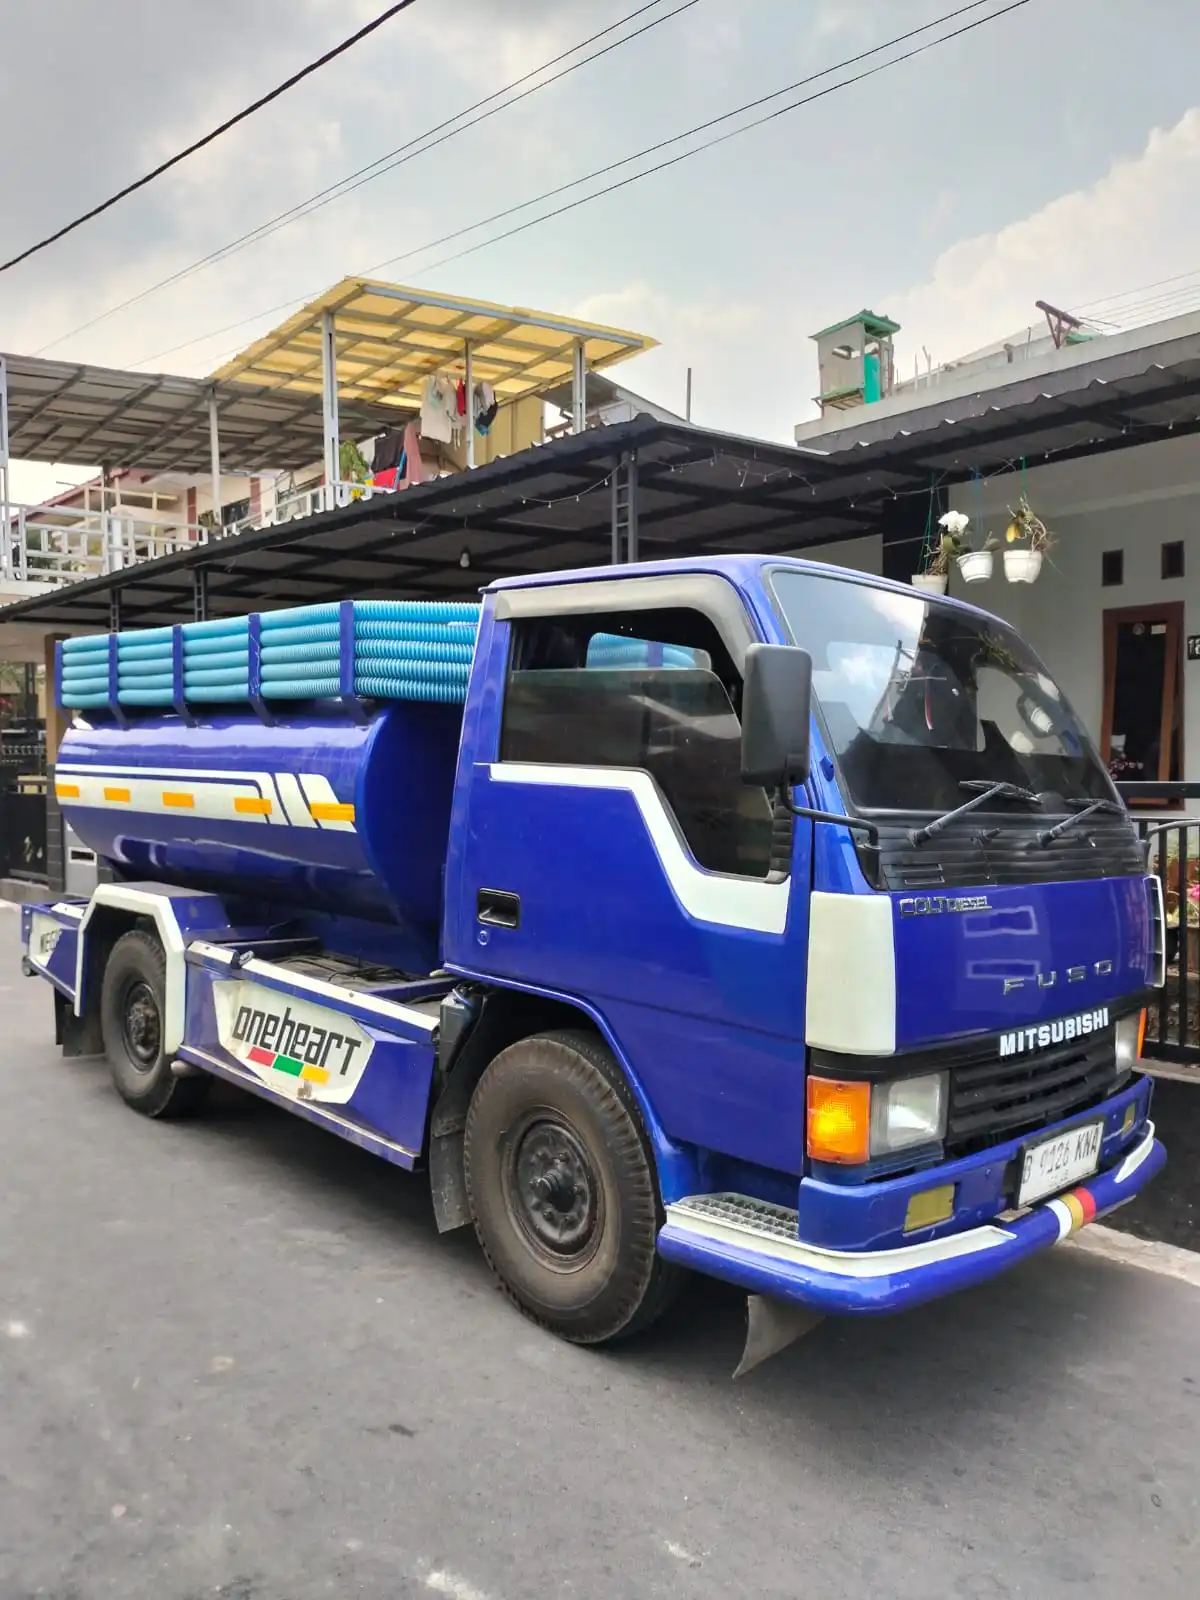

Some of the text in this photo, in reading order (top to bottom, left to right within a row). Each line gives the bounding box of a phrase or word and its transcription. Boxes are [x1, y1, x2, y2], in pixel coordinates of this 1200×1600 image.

[900, 896, 946, 917] COLT
[1003, 959, 1112, 996] FUSO
[1000, 1007, 1109, 1057] MITSUBISHI
